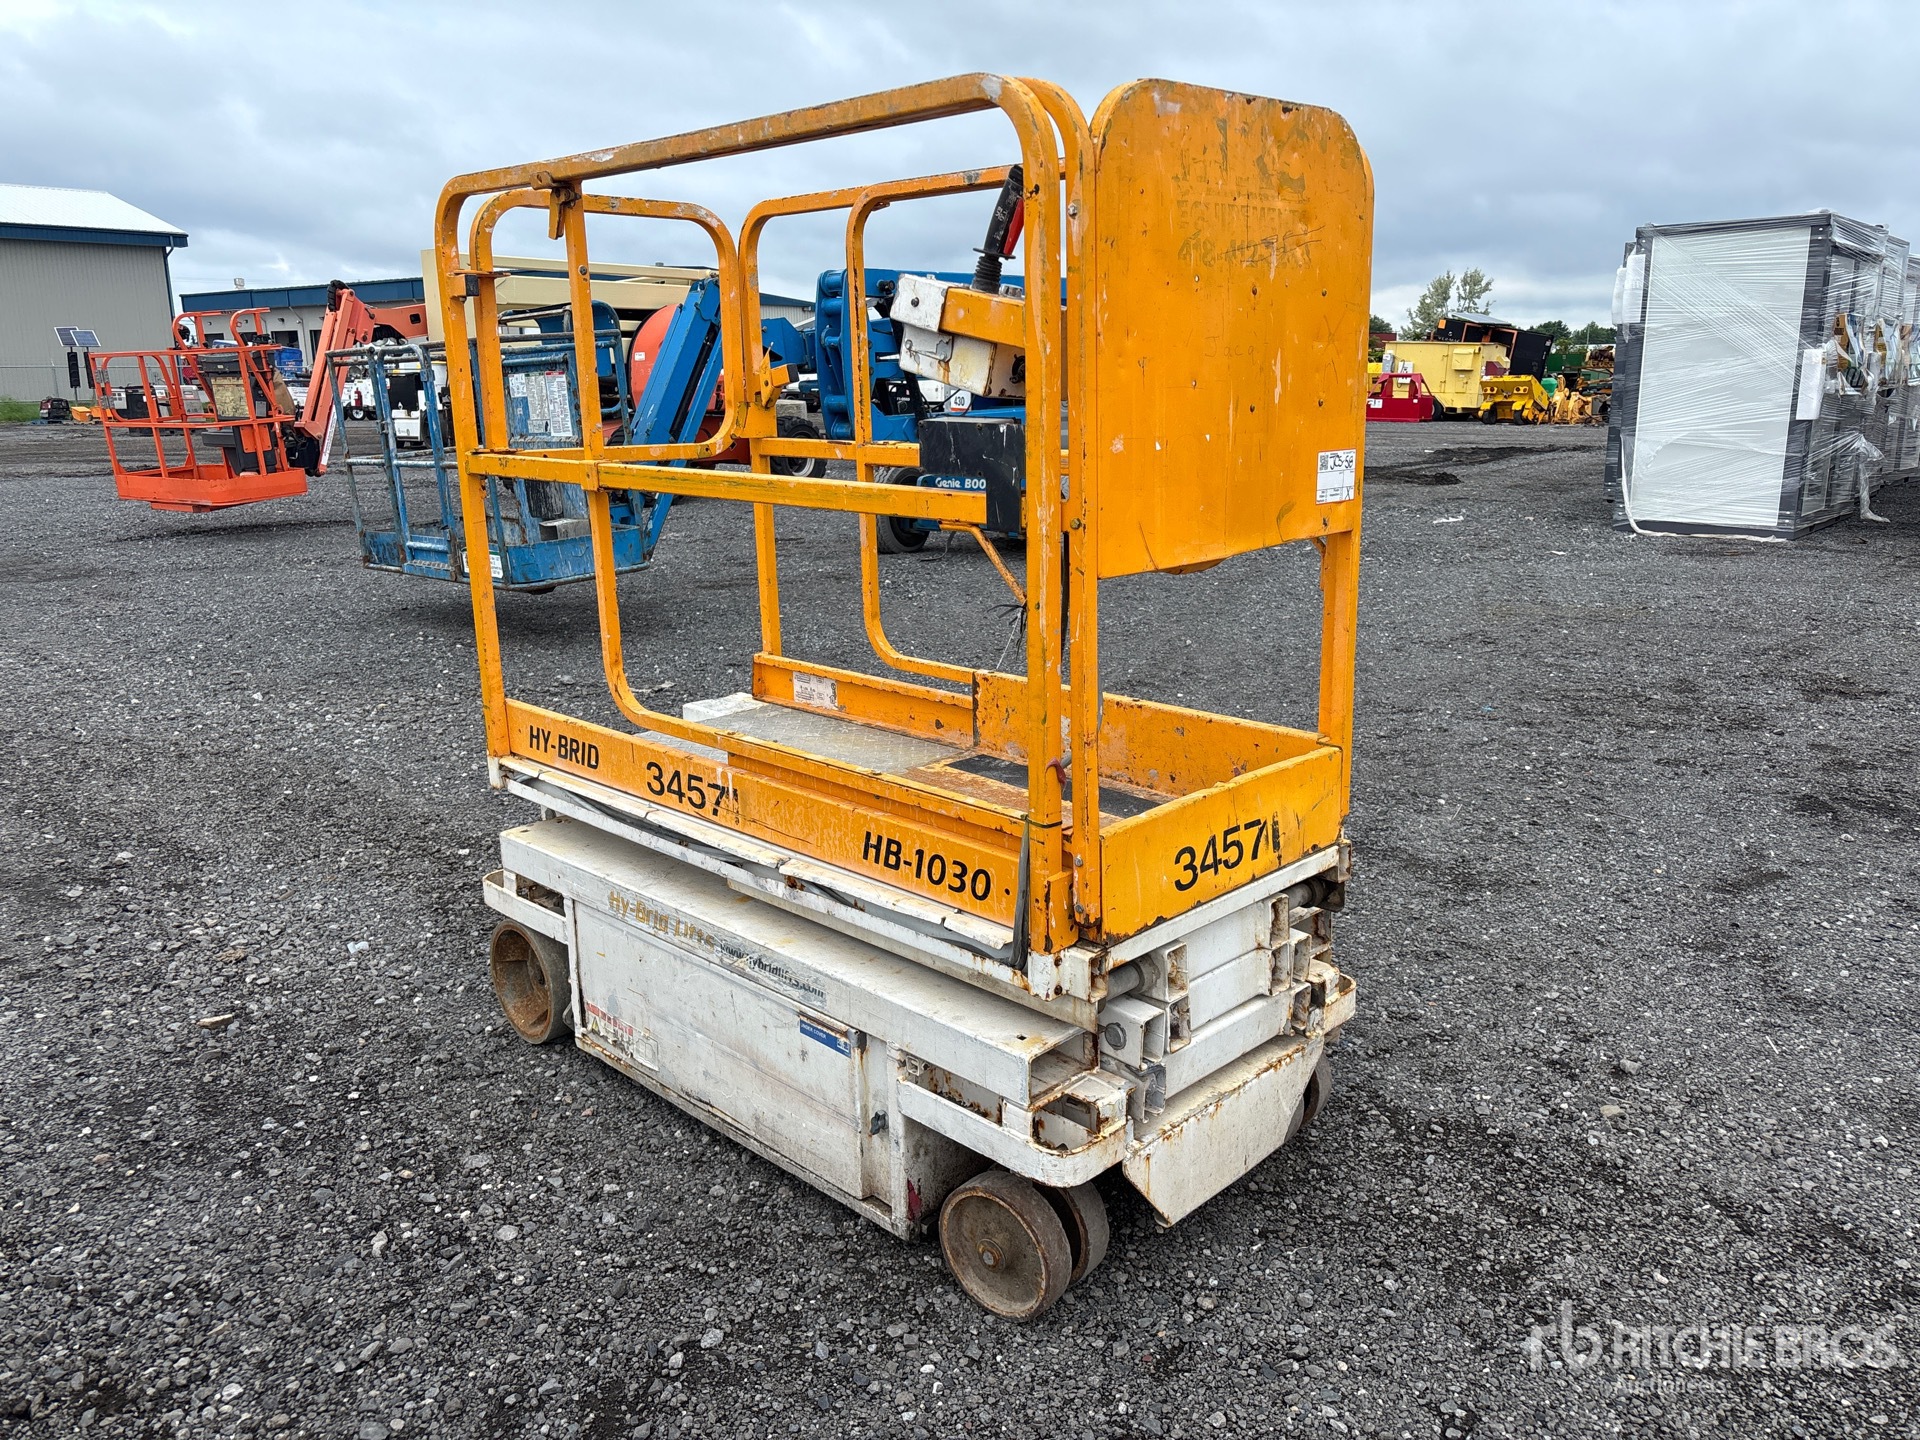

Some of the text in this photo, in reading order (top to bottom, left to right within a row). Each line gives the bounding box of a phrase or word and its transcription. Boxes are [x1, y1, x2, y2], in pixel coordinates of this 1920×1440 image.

[953, 396, 966, 407] 430
[935, 476, 961, 488] Genie
[529, 725, 599, 770] HY-BRID
[862, 830, 991, 901] HB-1030
